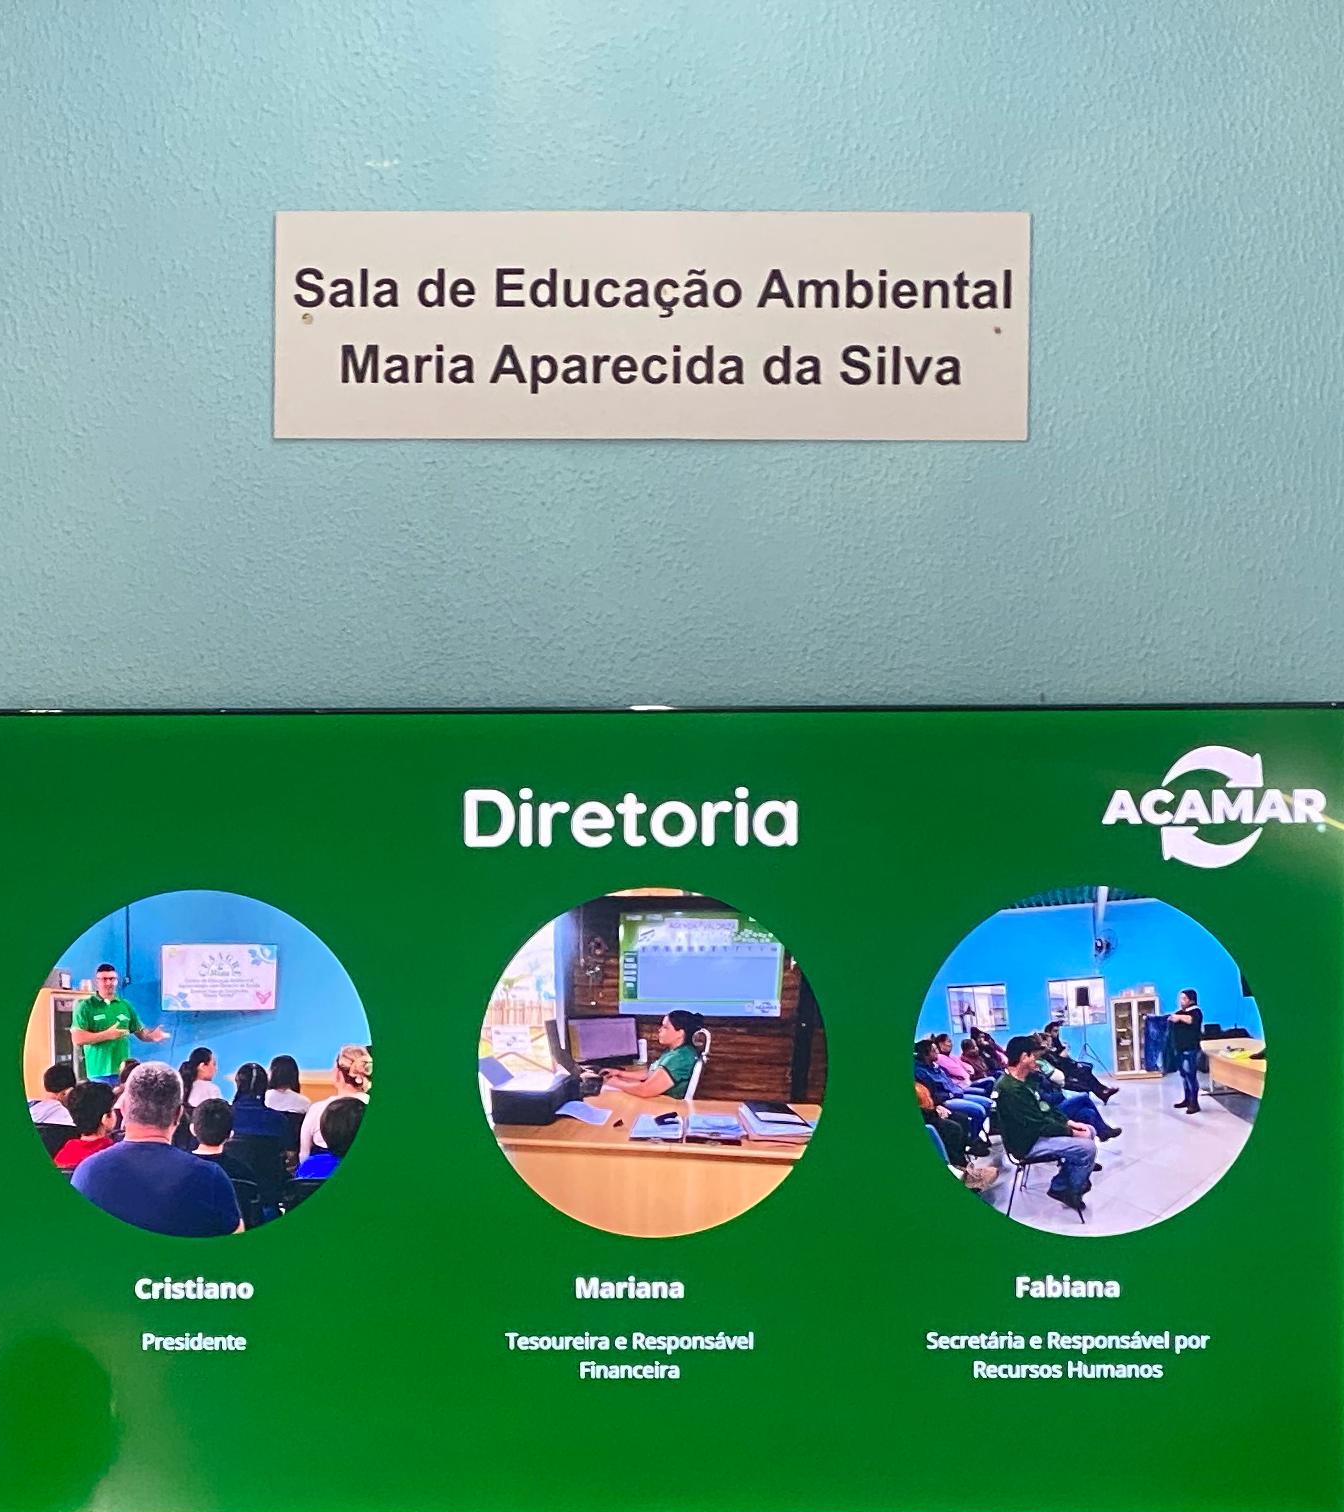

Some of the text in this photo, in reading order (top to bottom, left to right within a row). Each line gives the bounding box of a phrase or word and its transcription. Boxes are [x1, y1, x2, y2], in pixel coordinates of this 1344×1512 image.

[294, 267, 1013, 319] Sala de Educação Ambiental
[341, 344, 962, 395] Maria Aparecida da Silva
[463, 786, 799, 848] Diretoria
[1101, 788, 1327, 825] ACAMAR
[134, 1276, 255, 1300] Cristiano
[575, 1275, 685, 1300] Mariana
[1015, 1274, 1121, 1299] Fabiana
[141, 1332, 247, 1351] Presidente
[505, 1331, 754, 1355] Tesoureira e Responsável
[926, 1330, 1211, 1355] Secretária e Responsável por
[579, 1360, 681, 1380] Financeira
[973, 1360, 1164, 1379] Recursos Humanos
